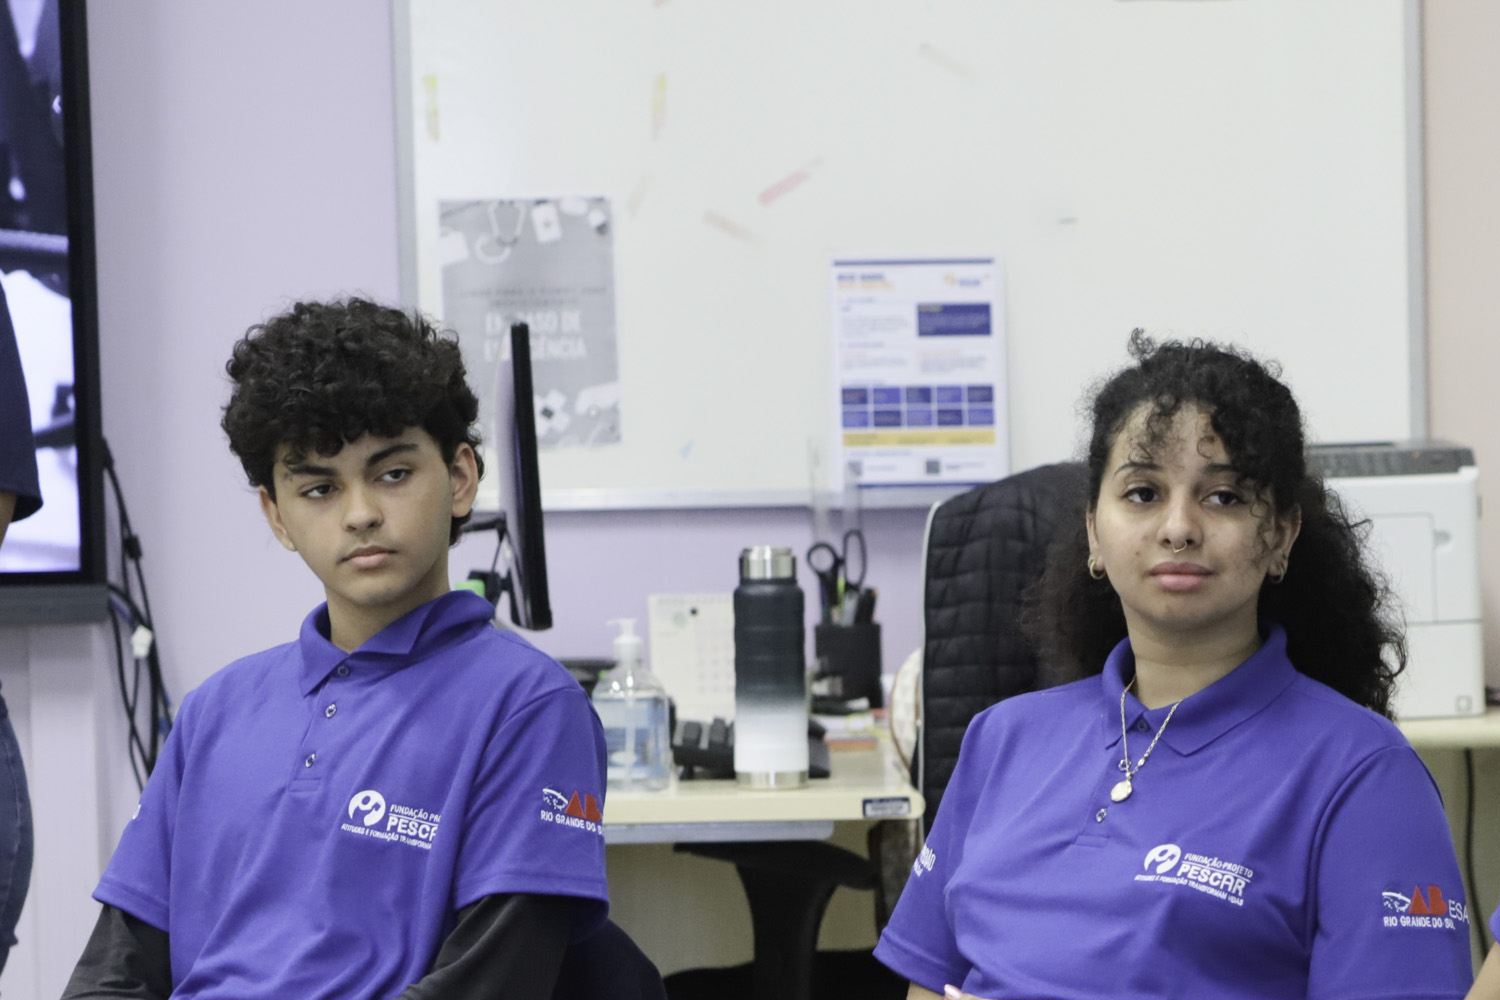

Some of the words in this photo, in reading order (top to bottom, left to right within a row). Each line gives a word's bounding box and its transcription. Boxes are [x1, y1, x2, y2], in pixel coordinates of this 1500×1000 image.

[390, 804, 428, 820] FUNDAÇÃO
[540, 810, 553, 822] RIO
[555, 813, 585, 829] GRANDE
[586, 821, 596, 832] DO
[1184, 853, 1221, 868] FUNDAÇÃO
[1222, 861, 1253, 878] PROJETO
[1177, 863, 1246, 896] PESCAR
[1383, 916, 1398, 927] RIO
[1400, 916, 1432, 928] GRANDE
[1432, 917, 1443, 928] DO
